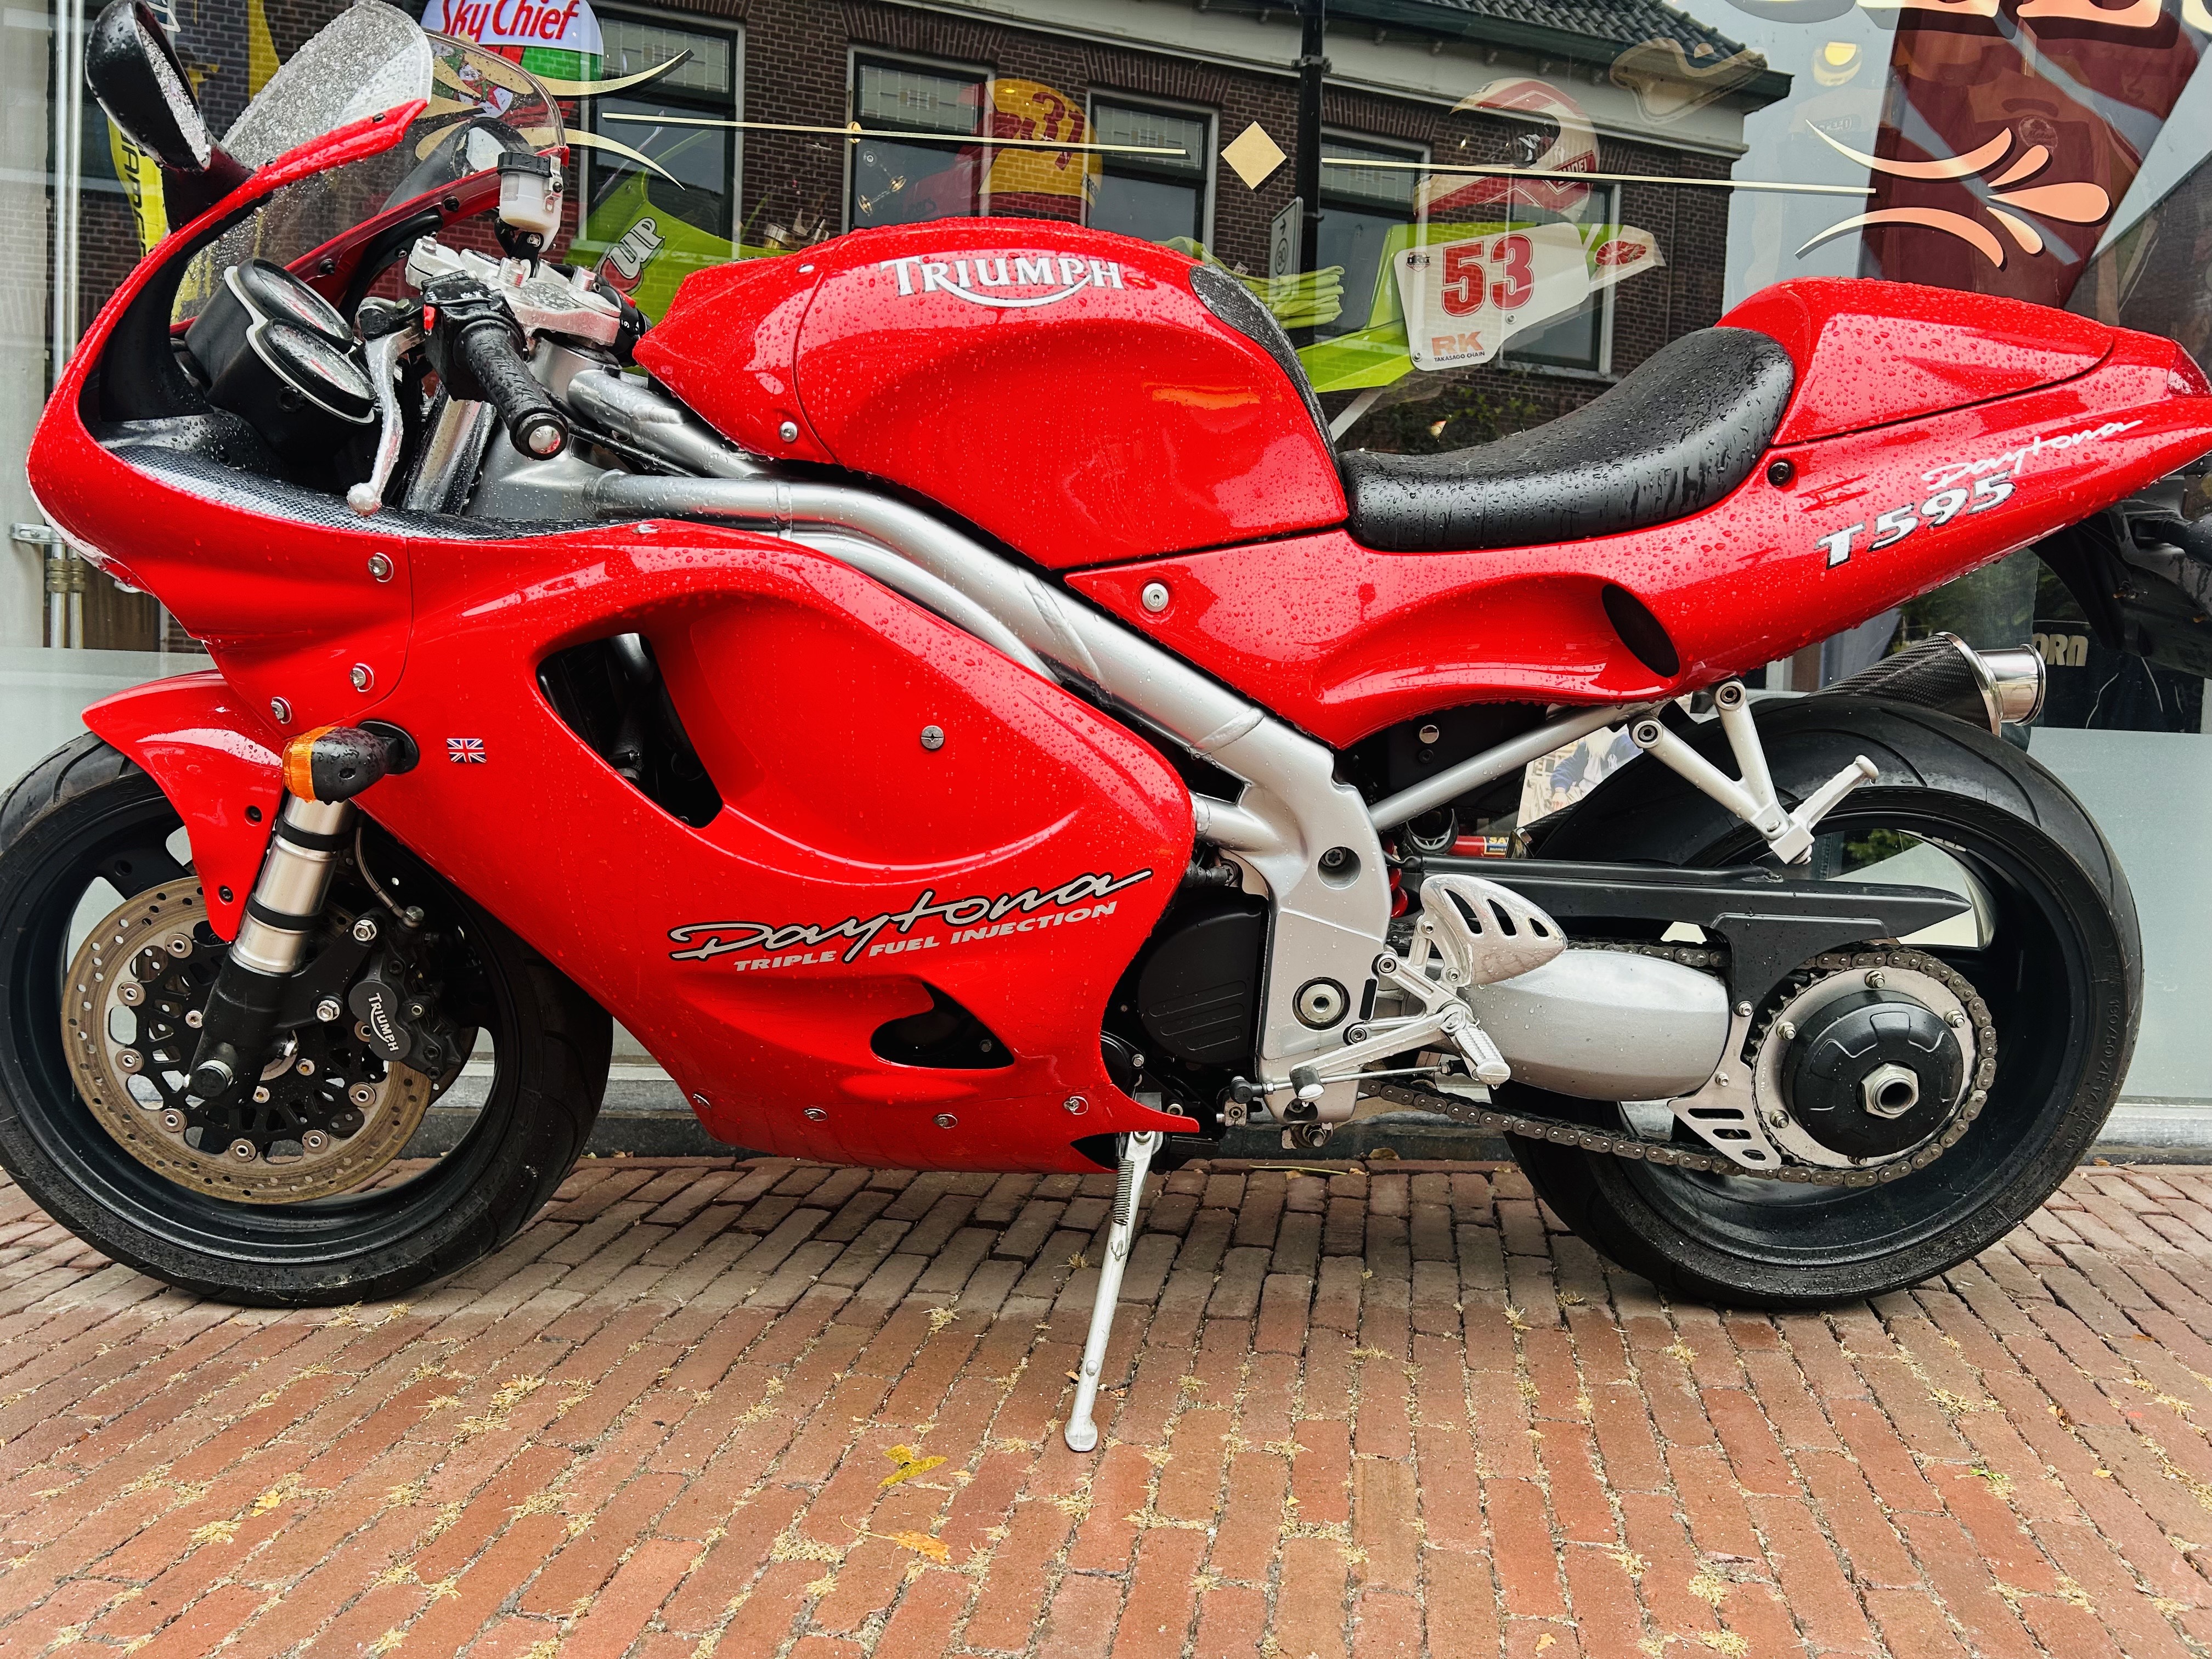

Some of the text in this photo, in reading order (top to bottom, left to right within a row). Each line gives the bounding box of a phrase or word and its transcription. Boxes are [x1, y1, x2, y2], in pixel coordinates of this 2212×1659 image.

[441, 0, 580, 42] Sky Chief
[879, 255, 1124, 307] TRIUMPH
[1442, 234, 1534, 317] 53
[1432, 331, 1484, 357] RK
[1434, 353, 1465, 362] TAKASAGO
[1922, 420, 2143, 491] Daytona
[1814, 470, 2017, 570] T595
[667, 870, 1153, 964] Daytona
[733, 900, 1118, 972] TRIPLE FUEL INJECTION
[369, 992, 399, 1052] TRIUMPH
